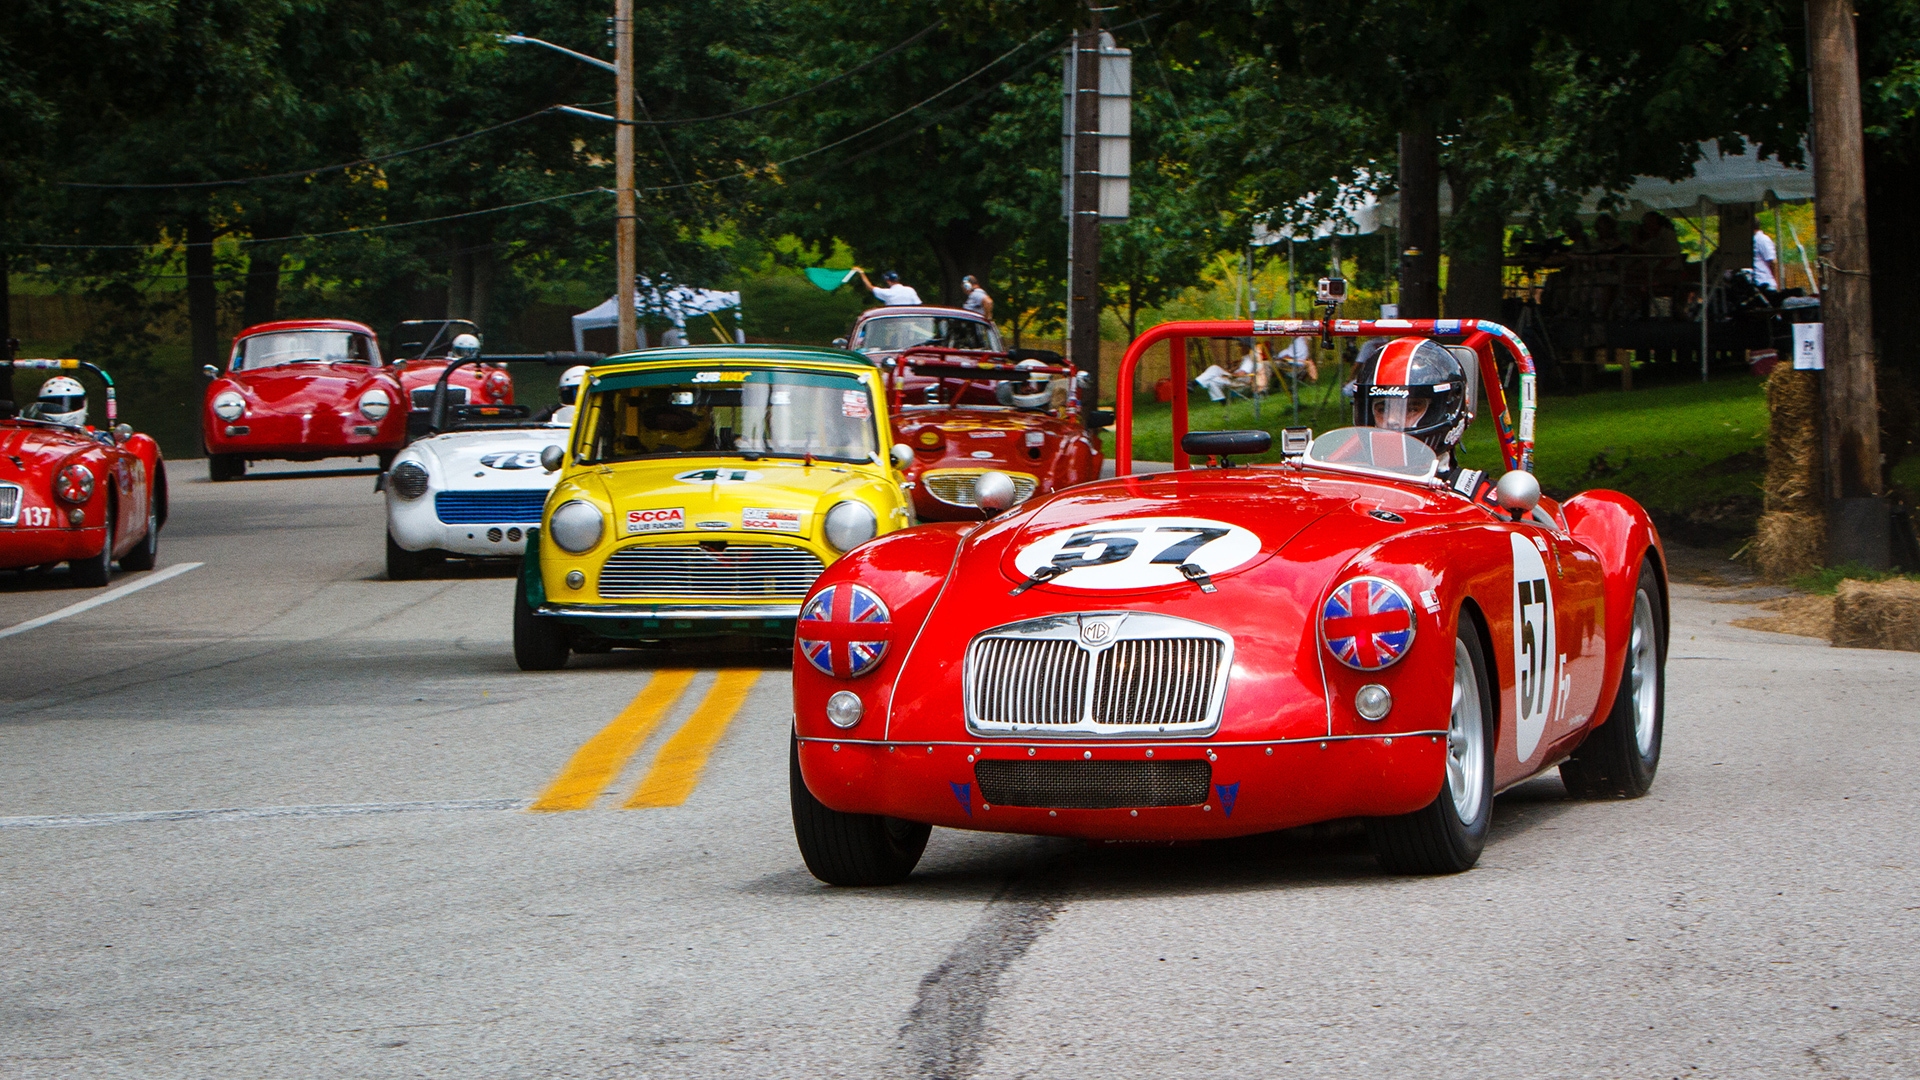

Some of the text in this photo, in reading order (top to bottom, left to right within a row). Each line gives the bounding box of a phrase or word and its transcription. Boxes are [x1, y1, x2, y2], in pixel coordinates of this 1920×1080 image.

[1368, 385, 1410, 399] Stinkbug
[487, 452, 542, 468] 78
[679, 469, 747, 481] 41
[22, 506, 52, 527] 137
[628, 509, 682, 523] SCCA
[628, 521, 684, 532] CLUB RACING
[743, 519, 779, 529] SCCA
[1050, 525, 1232, 568] 57
[1086, 623, 1107, 640] MG
[1517, 578, 1548, 721] 57
